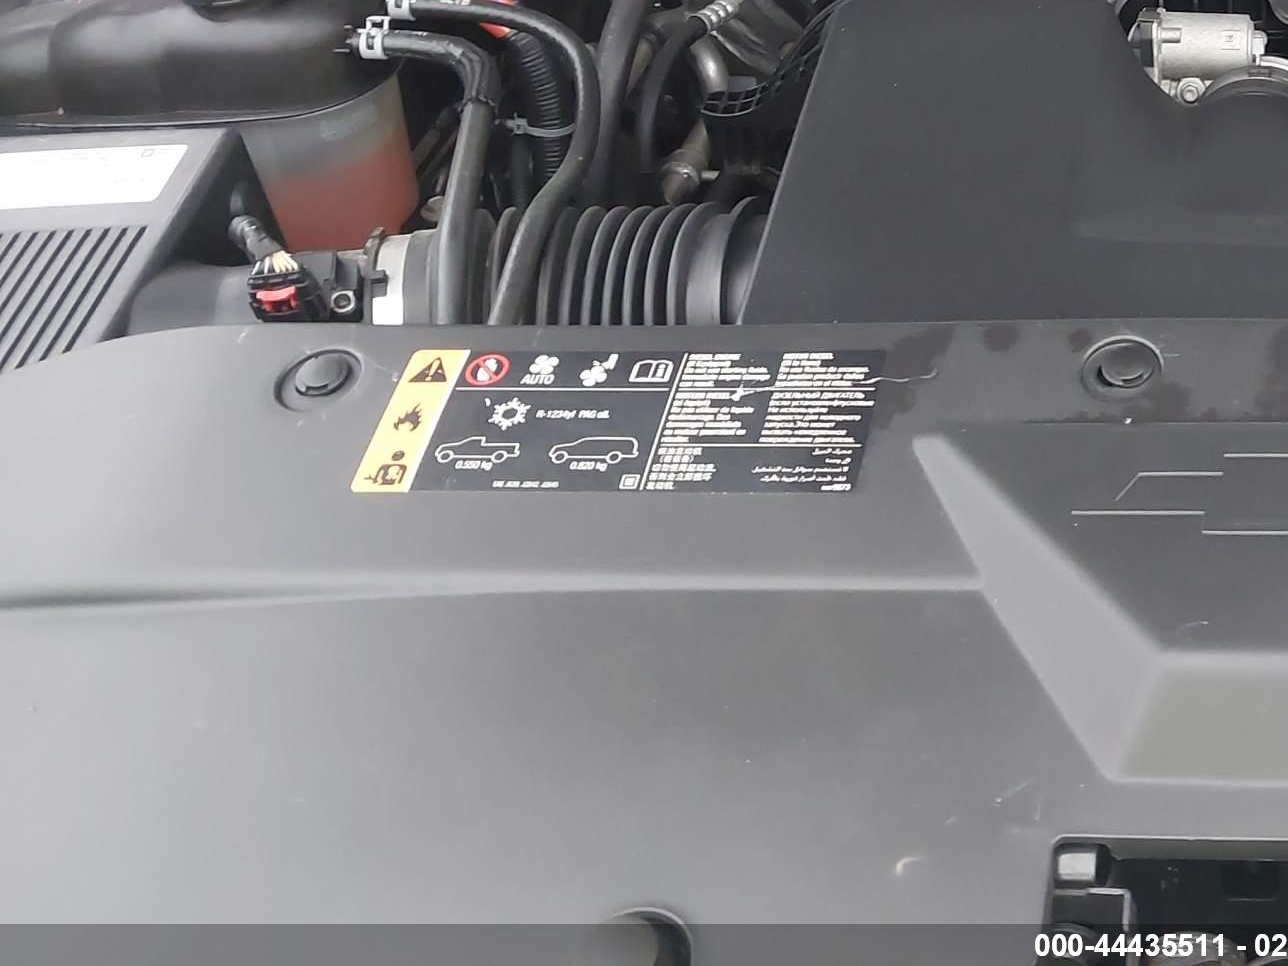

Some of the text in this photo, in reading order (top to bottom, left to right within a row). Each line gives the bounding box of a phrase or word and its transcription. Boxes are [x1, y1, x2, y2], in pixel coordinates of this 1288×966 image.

[520, 374, 555, 385] AUTO
[480, 460, 493, 471] kg
[595, 461, 608, 472] kg
